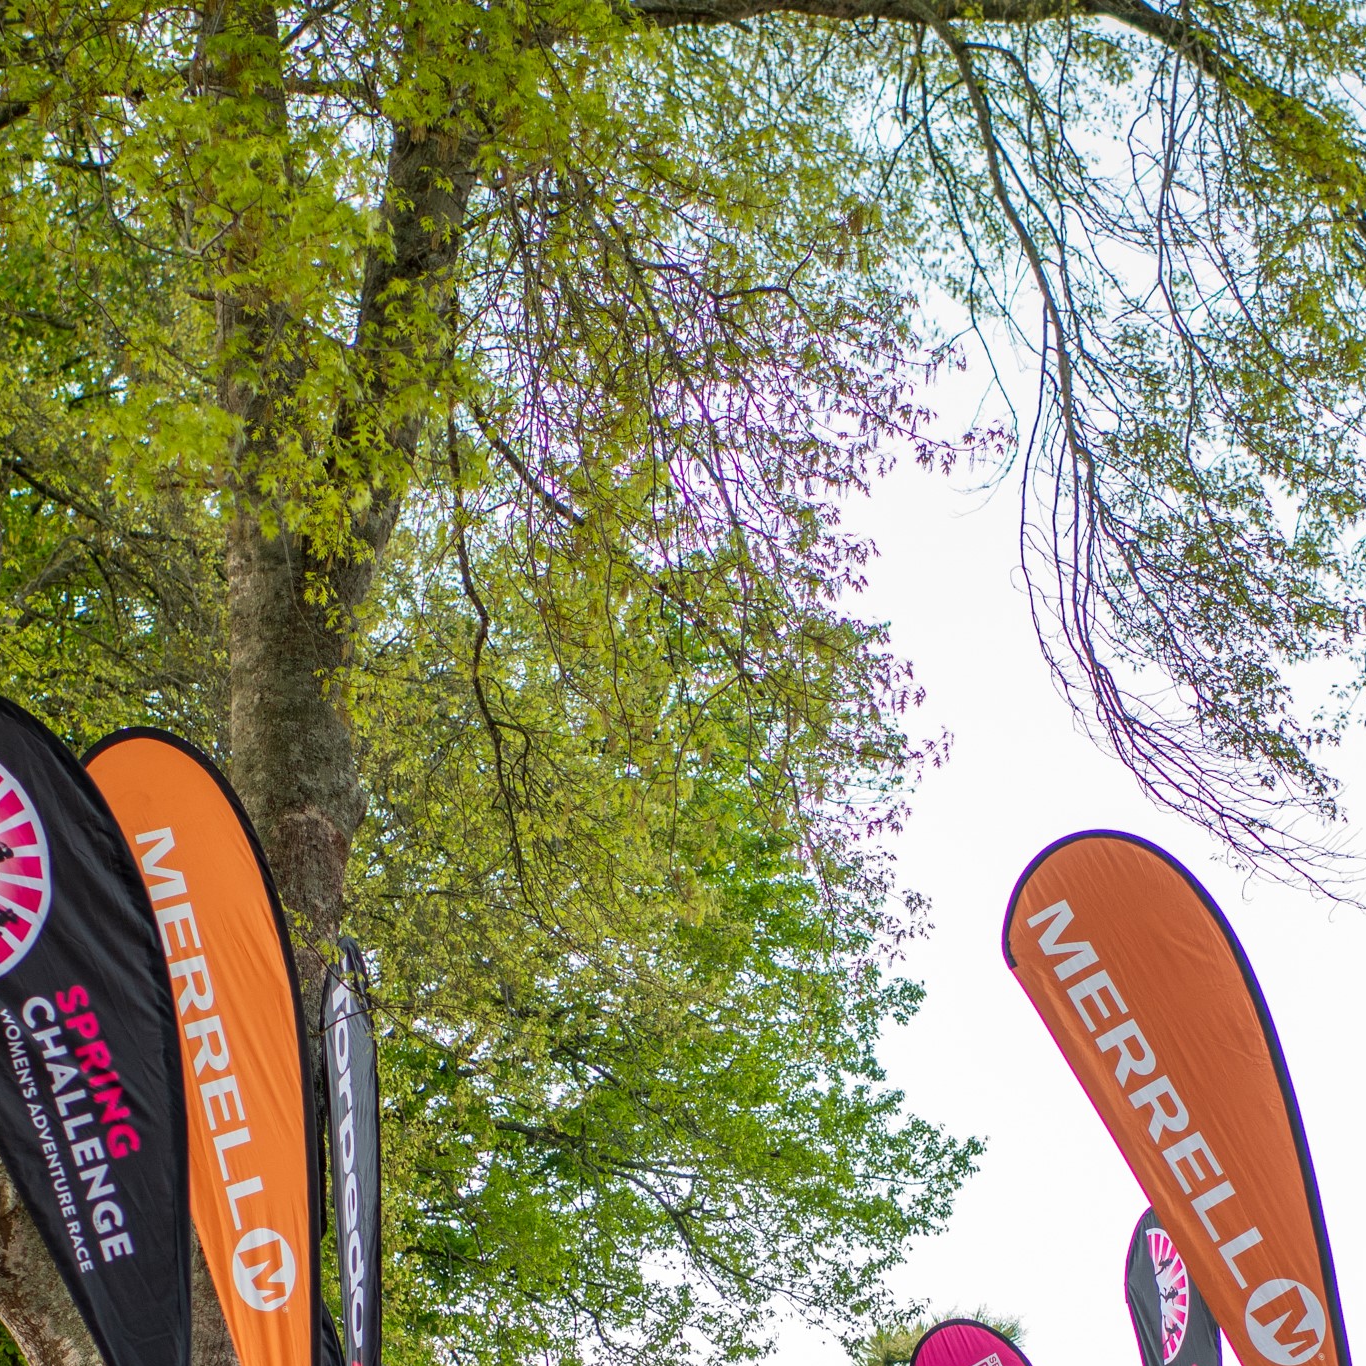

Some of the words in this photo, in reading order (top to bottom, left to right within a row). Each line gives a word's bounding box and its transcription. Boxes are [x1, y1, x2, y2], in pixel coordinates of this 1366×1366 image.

[0, 1007, 38, 1099] WOMEN'S
[26, 1102, 77, 1218] ADVENTURE
[66, 1221, 94, 1274] RACE
[22, 996, 134, 1263] CHALLENGE
[55, 984, 141, 1159] SPRING
[135, 826, 264, 1230] MERRELL
[1026, 898, 1264, 1290] MERRELL
